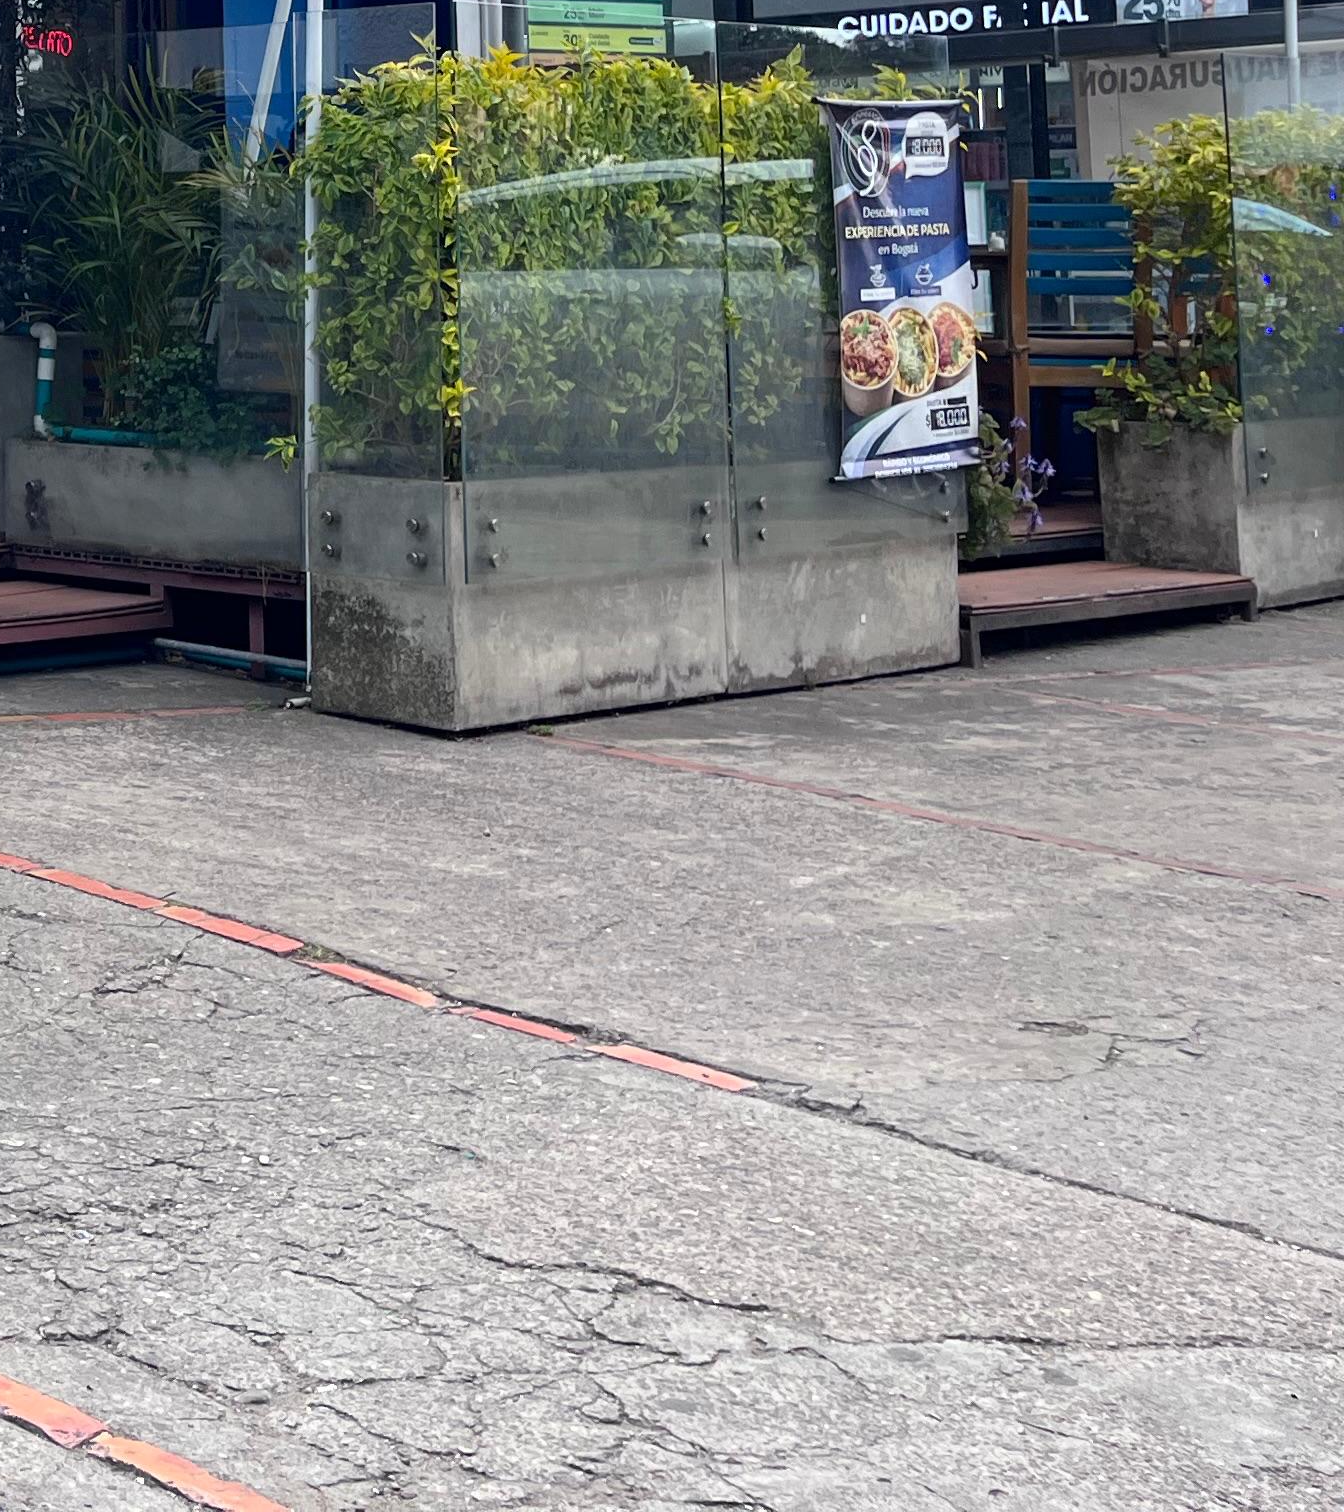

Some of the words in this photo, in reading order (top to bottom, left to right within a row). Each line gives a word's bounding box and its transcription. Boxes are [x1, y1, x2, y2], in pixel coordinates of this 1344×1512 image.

[837, 7, 974, 38] CUIDADO
[845, 225, 906, 239] EXPERIENCIA
[906, 224, 920, 236] DE
[921, 223, 950, 235] PASTA
[878, 246, 890, 255] en
